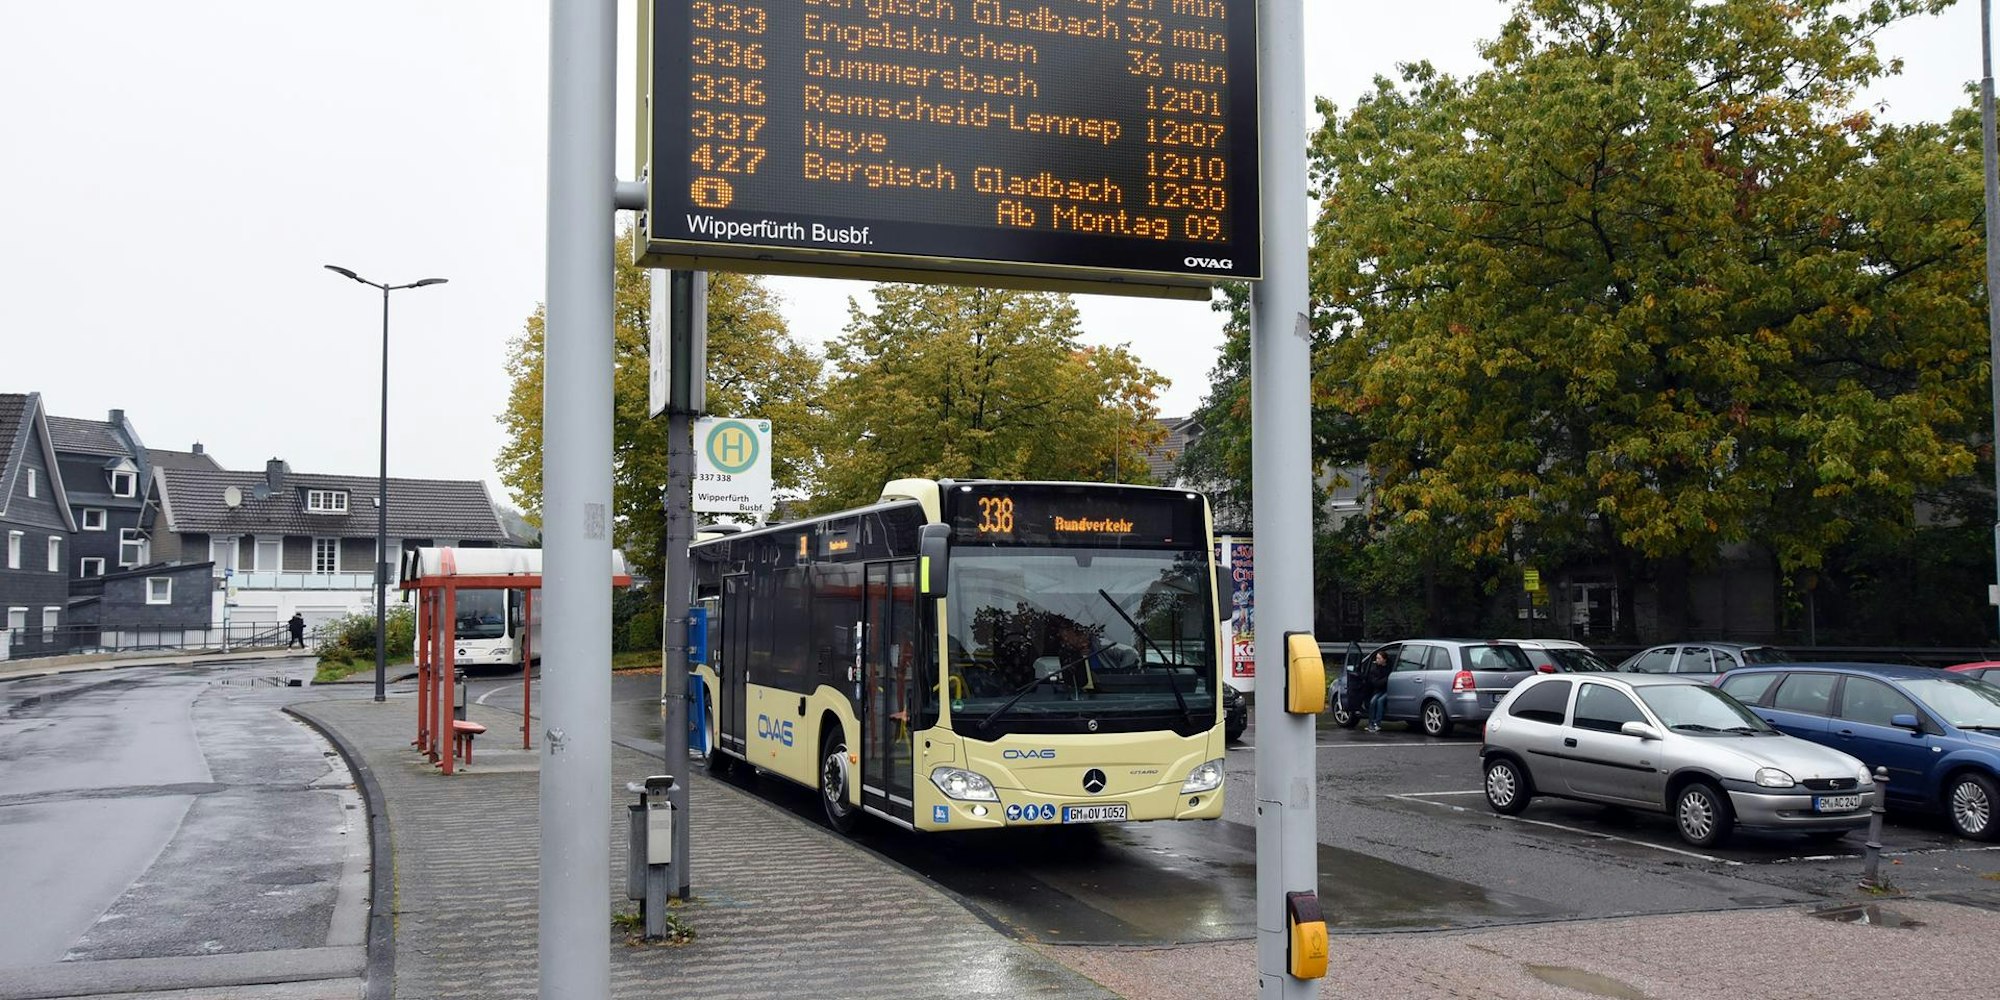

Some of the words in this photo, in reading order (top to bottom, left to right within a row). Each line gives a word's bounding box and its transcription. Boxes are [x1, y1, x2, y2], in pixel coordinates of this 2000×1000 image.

[805, 0, 954, 21] gisch
[972, 0, 1120, 40] Gladbach
[1127, 16, 1162, 45] 32
[1173, 26, 1226, 51] min
[691, 2, 767, 34] 333
[805, 13, 1037, 64] Engelskirchen
[1127, 49, 1163, 77] 36
[1174, 59, 1226, 84] min
[691, 37, 767, 70] 336
[805, 49, 1038, 97] Gummersbach
[1147, 85, 1222, 116] 12:01
[691, 74, 767, 105] 336
[805, 84, 1121, 145] Remscheid-Lennep
[1147, 118, 1225, 148] 12:07
[691, 110, 767, 142] 337
[805, 120, 887, 153] Neye
[1147, 151, 1226, 182] 12:10
[691, 143, 767, 174] 427
[804, 152, 956, 190] Bergisch
[974, 166, 1121, 203] Gladbach
[1148, 181, 1226, 212] 12:30
[686, 214, 805, 240] Wipperfürth
[812, 223, 874, 246] Busbf.
[997, 200, 1035, 227] Ab
[1053, 203, 1169, 240] Montag
[1185, 214, 1227, 241] 09.
[1184, 256, 1234, 270] OVAG
[722, 432, 744, 463] H
[700, 473, 714, 481] 337
[716, 474, 732, 482] 338
[698, 493, 749, 503] Wipperfürth
[740, 504, 765, 512] Busbf.
[978, 497, 1014, 532] 338
[1055, 516, 1133, 533] Rundverkehr
[758, 713, 793, 747] OVAG
[1003, 749, 1056, 760] OVAG
[1102, 806, 1125, 819] 1052
